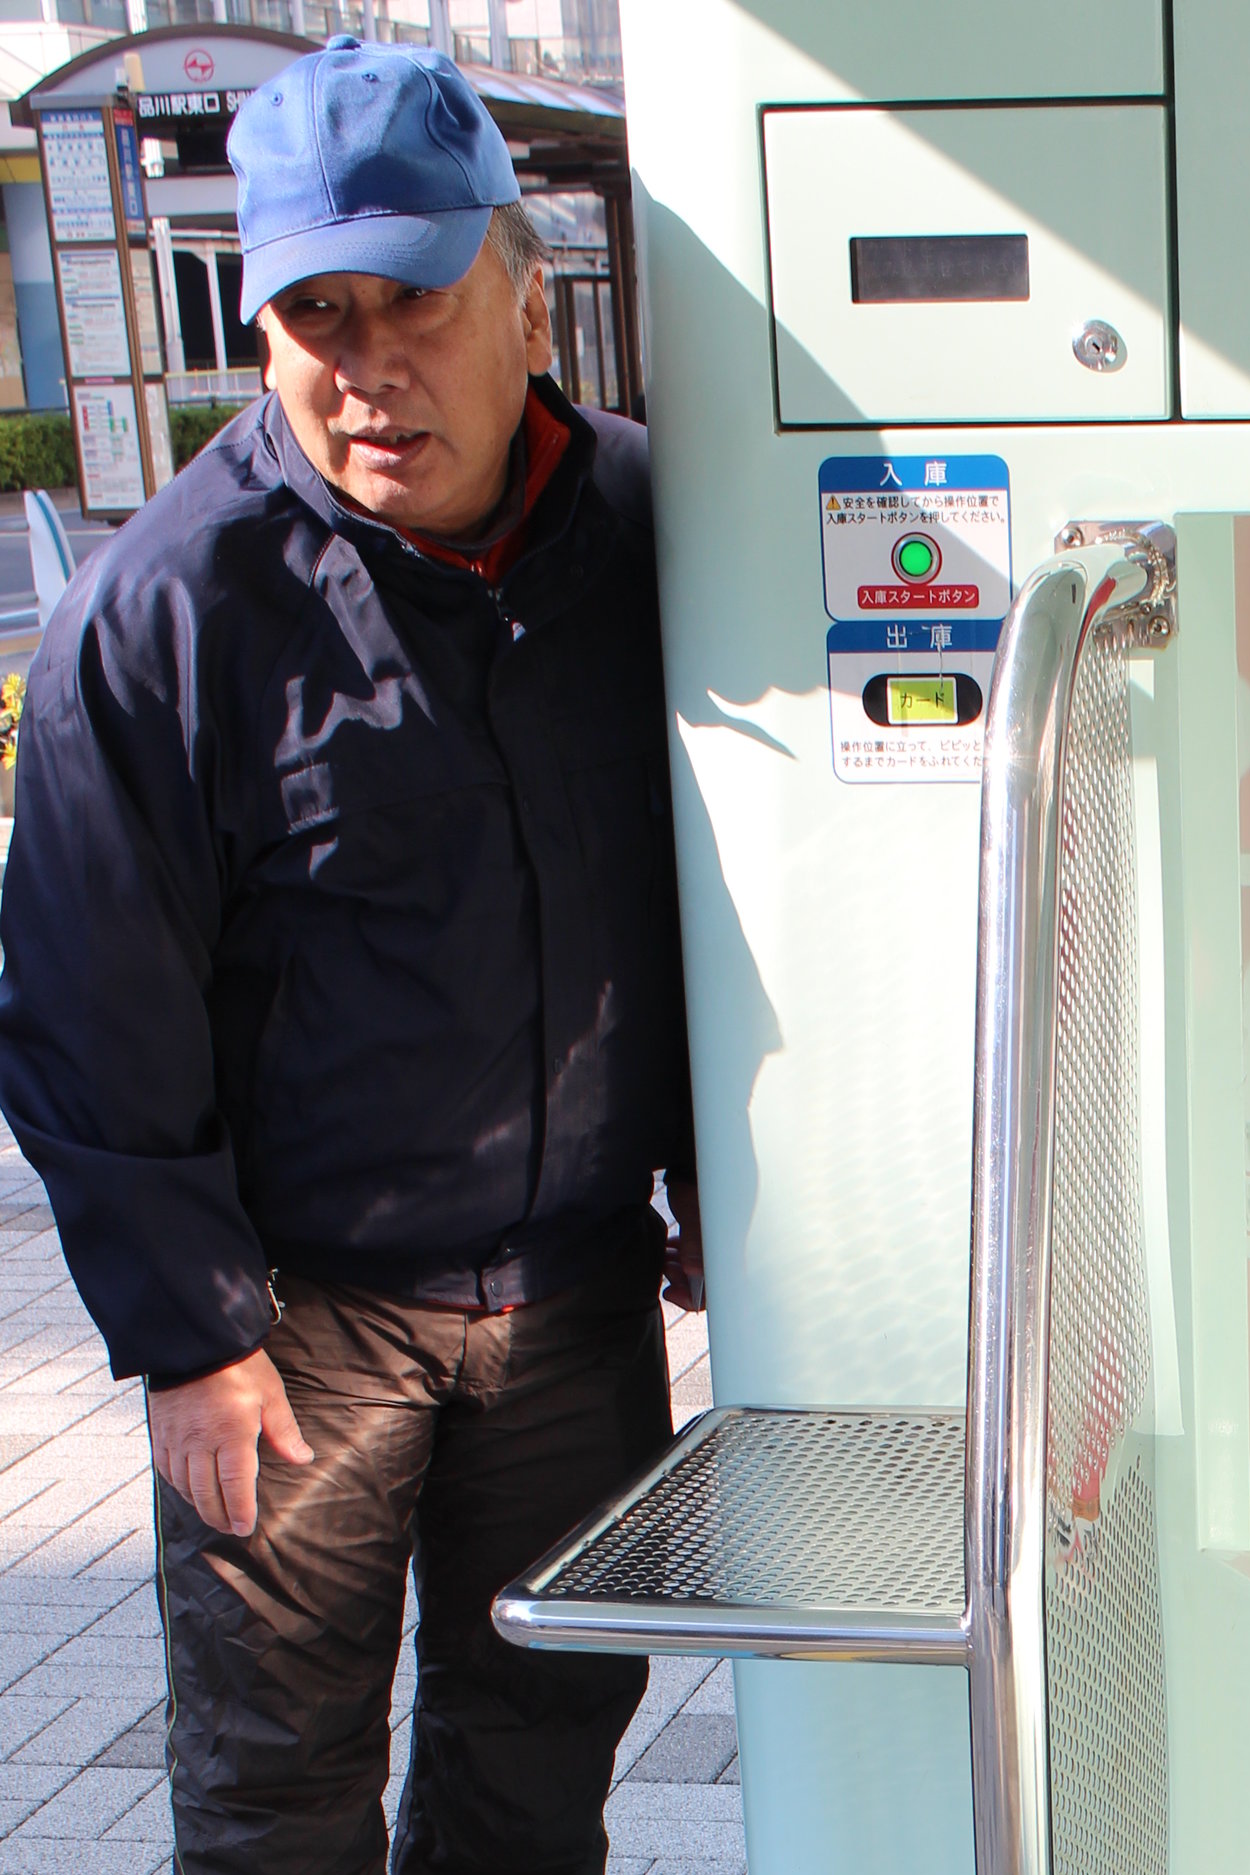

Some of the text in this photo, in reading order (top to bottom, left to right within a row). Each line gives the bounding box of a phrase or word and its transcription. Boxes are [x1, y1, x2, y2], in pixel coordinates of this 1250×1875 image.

[138, 92, 220, 118] 品川駅東口
[880, 461, 947, 486] 入庫
[843, 496, 999, 508] 安全を確認してから操作位置で
[826, 511, 1005, 524] 入庫スタートボタンを押してください。
[862, 590, 976, 604] 入庫スタートボタン
[887, 624, 952, 649] 出庫
[901, 692, 945, 708] カード
[841, 740, 981, 752] 操作位置に立って、ピピッと
